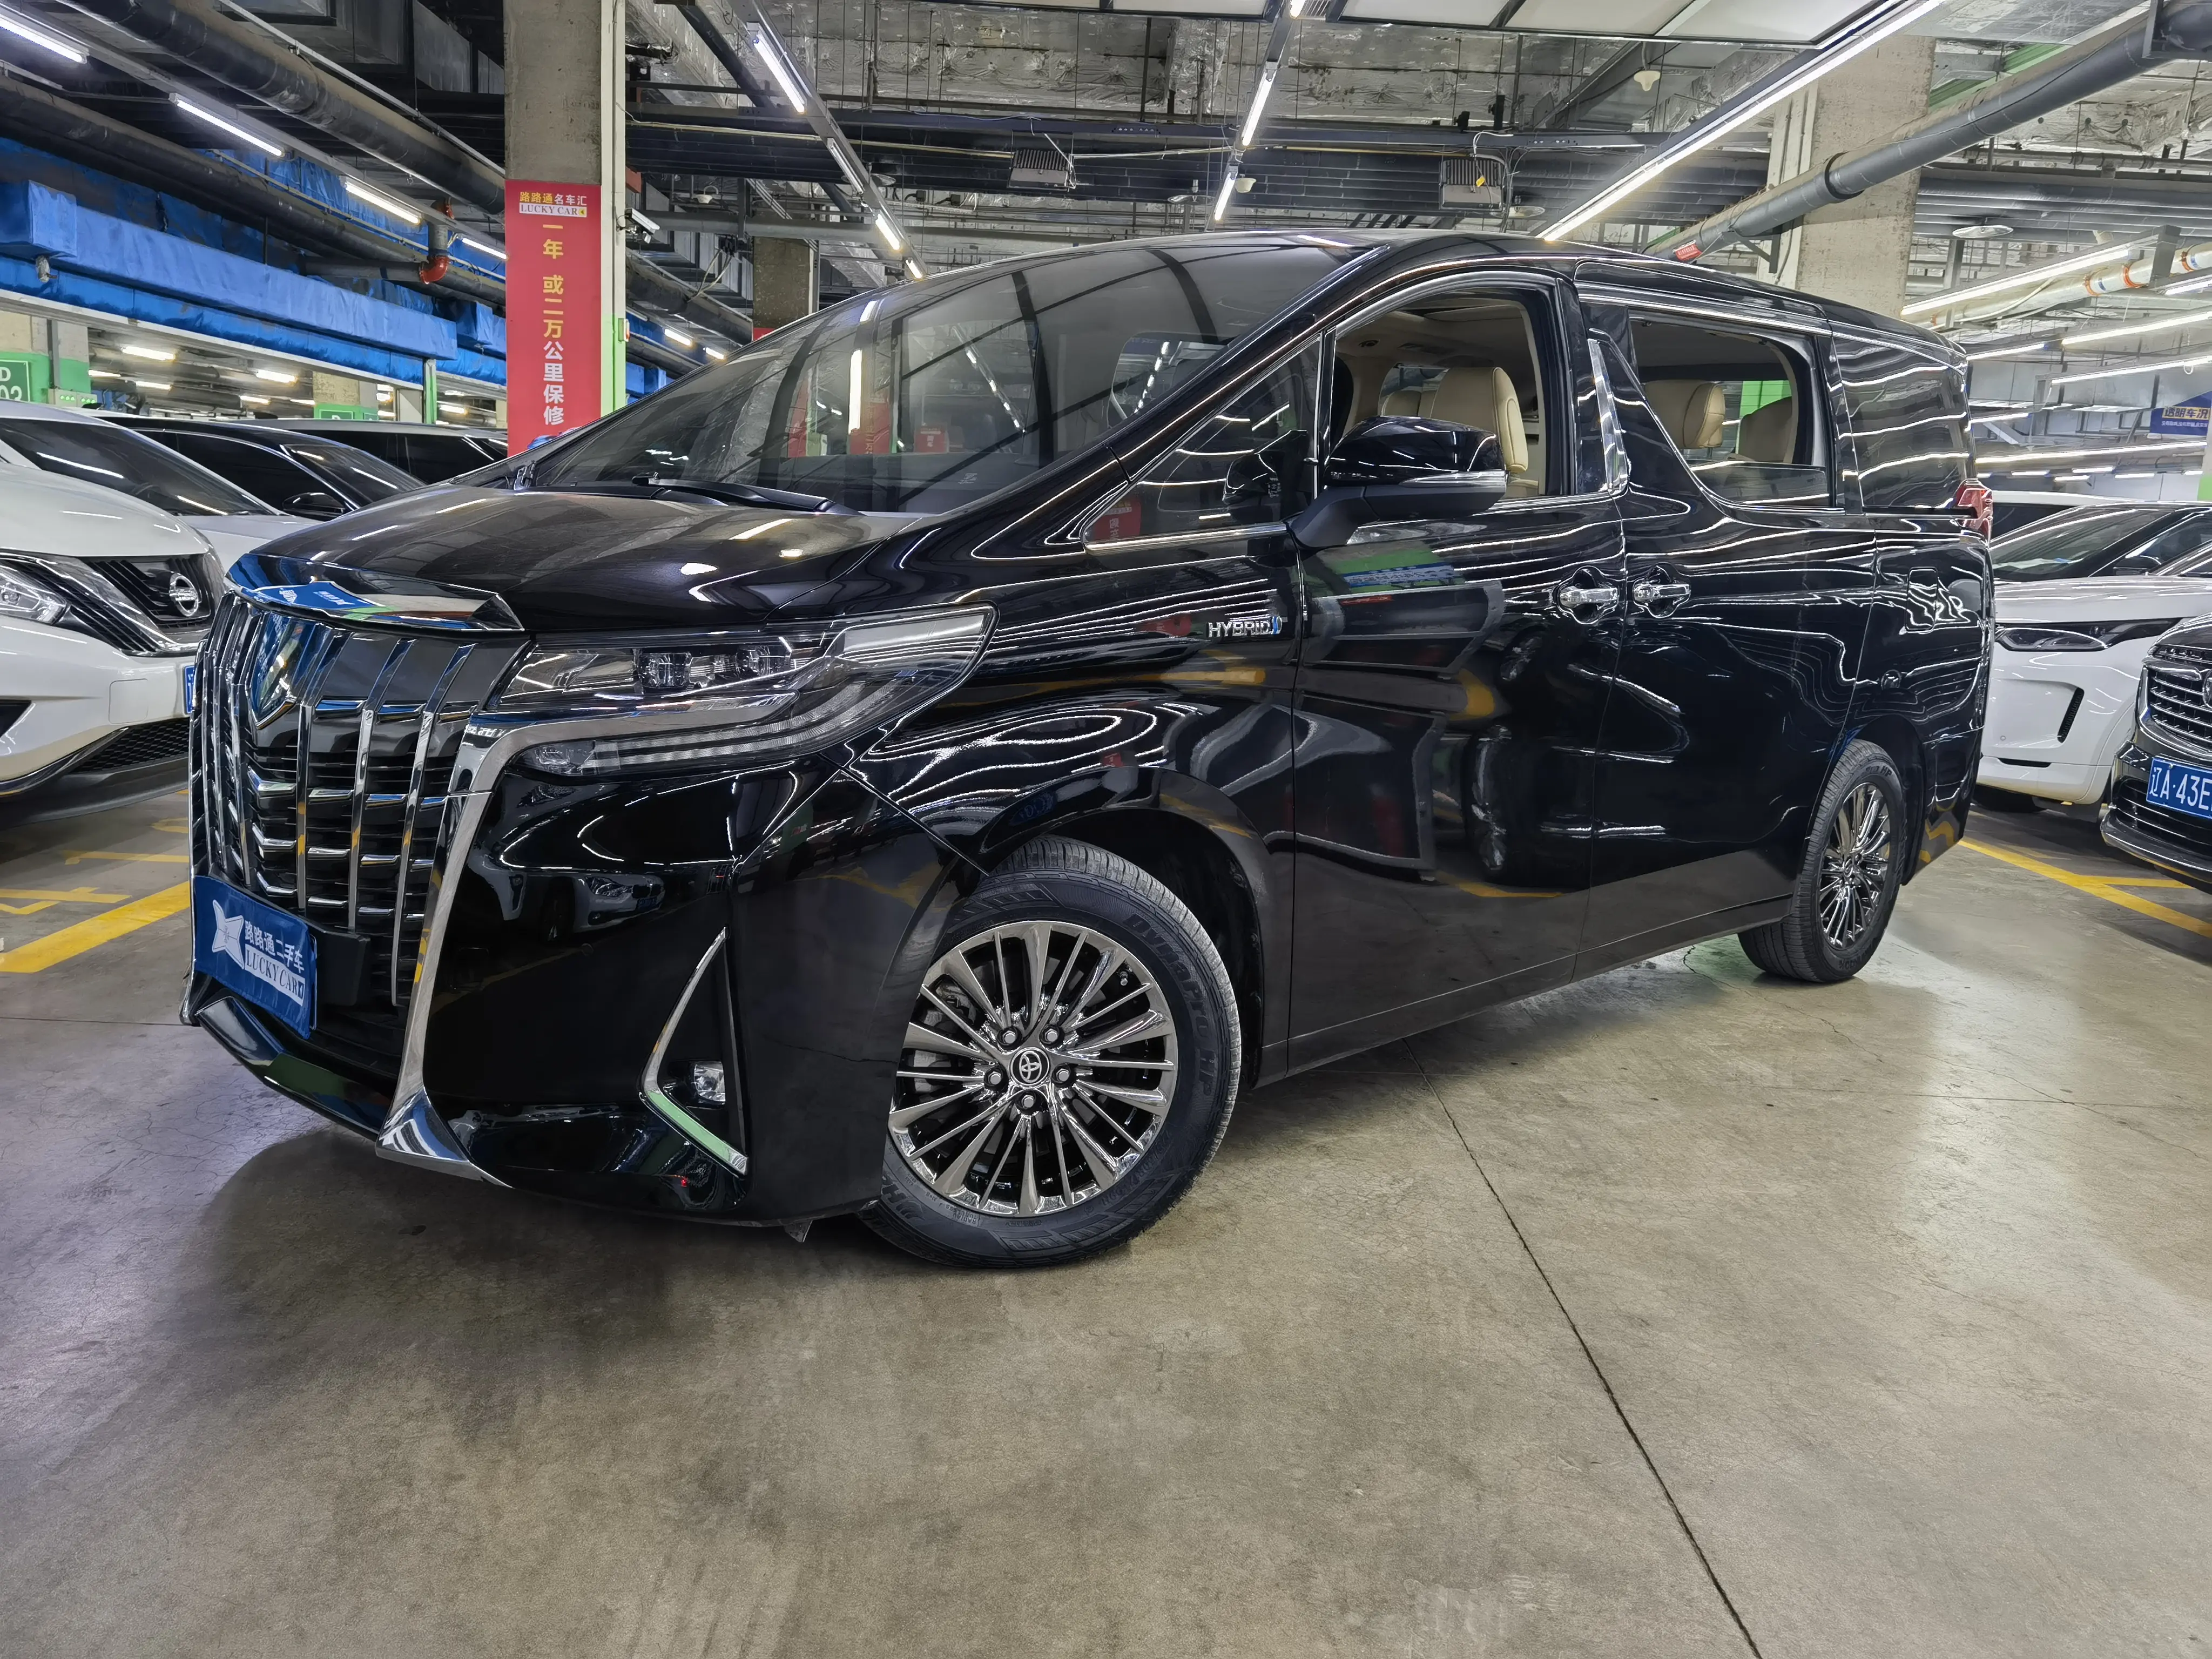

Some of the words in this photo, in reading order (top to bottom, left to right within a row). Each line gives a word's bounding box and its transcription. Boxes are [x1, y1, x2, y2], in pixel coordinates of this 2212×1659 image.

[520, 191, 587, 206] 路路通名车汇
[521, 204, 555, 214] LUCKY
[557, 206, 578, 215] CAR
[2164, 408, 2209, 419] 透明车况
[1208, 621, 1271, 638] HYBRID
[2149, 766, 2212, 812] 辽A·43E
[245, 920, 305, 974] 路路通二手车
[246, 947, 279, 982] LUCKY
[279, 969, 298, 996] CAR
